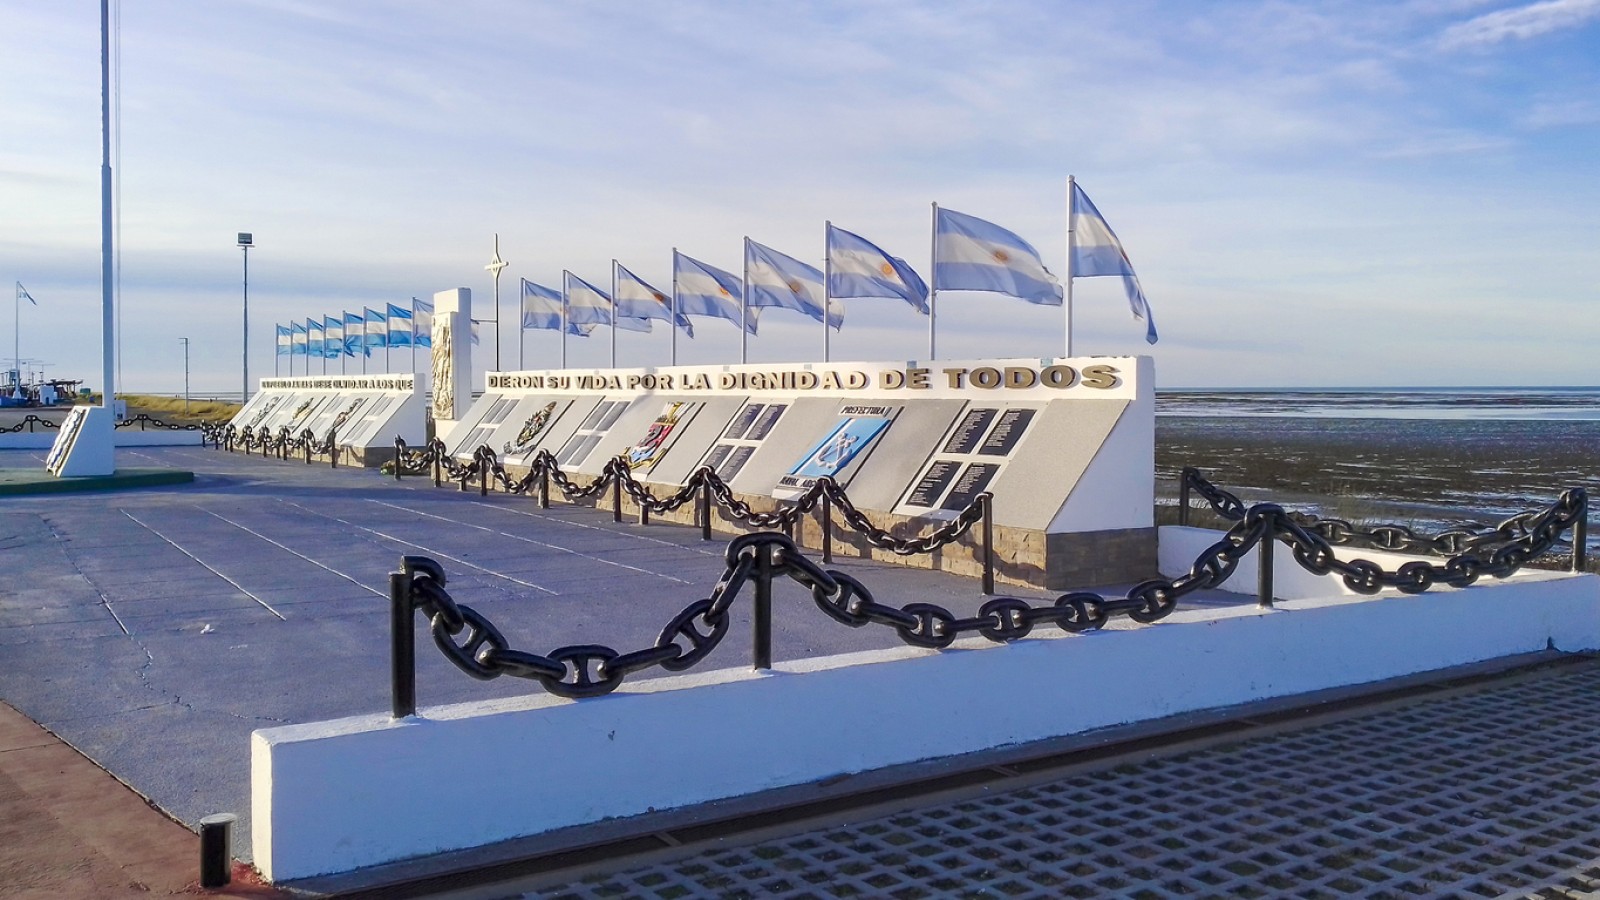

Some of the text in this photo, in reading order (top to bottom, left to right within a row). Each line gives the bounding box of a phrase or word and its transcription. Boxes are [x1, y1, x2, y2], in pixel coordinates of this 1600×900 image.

[395, 380, 413, 390] QUE
[488, 364, 1122, 390] DIERON SU VIDA POR LA DIGNIDAD DE TODOS
